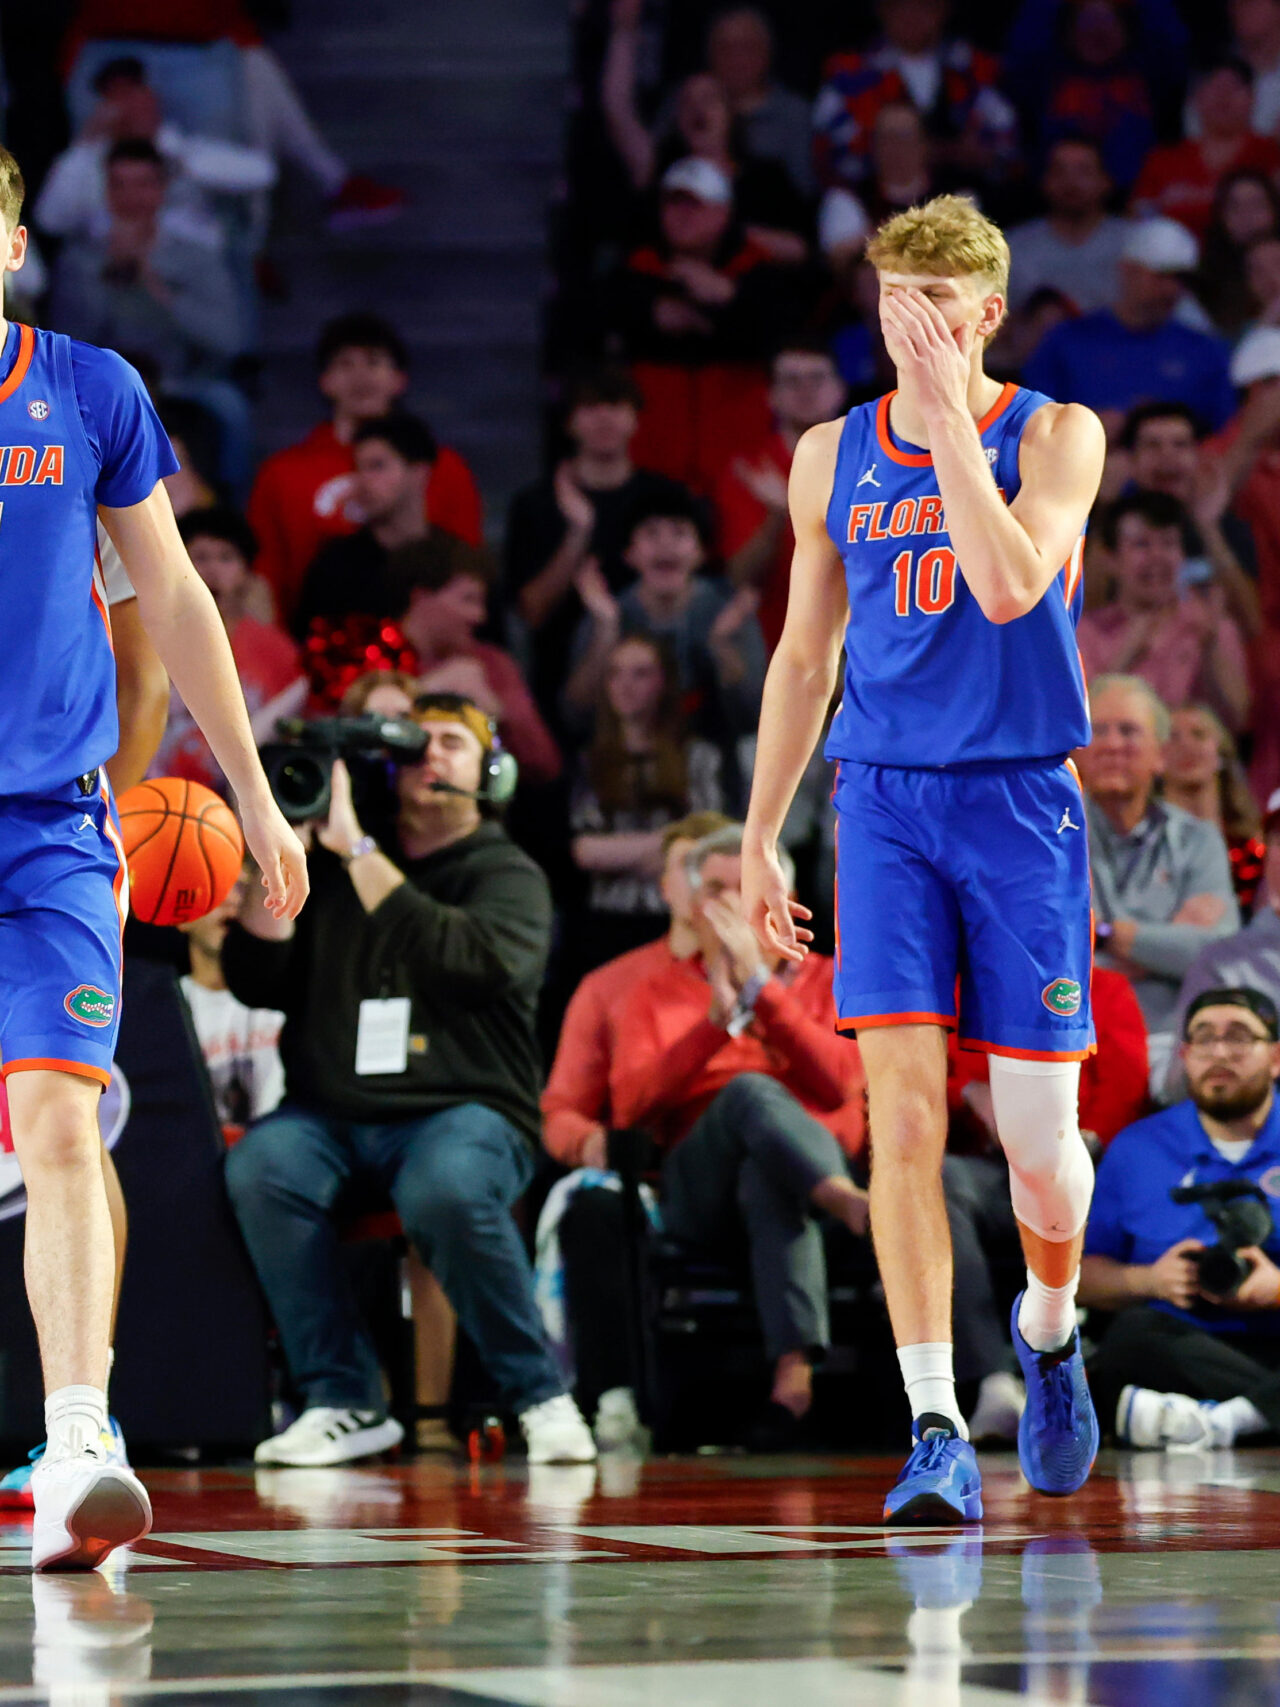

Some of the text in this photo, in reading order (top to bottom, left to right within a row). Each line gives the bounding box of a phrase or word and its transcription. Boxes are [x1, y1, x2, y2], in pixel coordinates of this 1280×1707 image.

[29, 400, 49, 420] SEC
[847, 494, 950, 543] FLOR
[893, 546, 958, 617] 10
